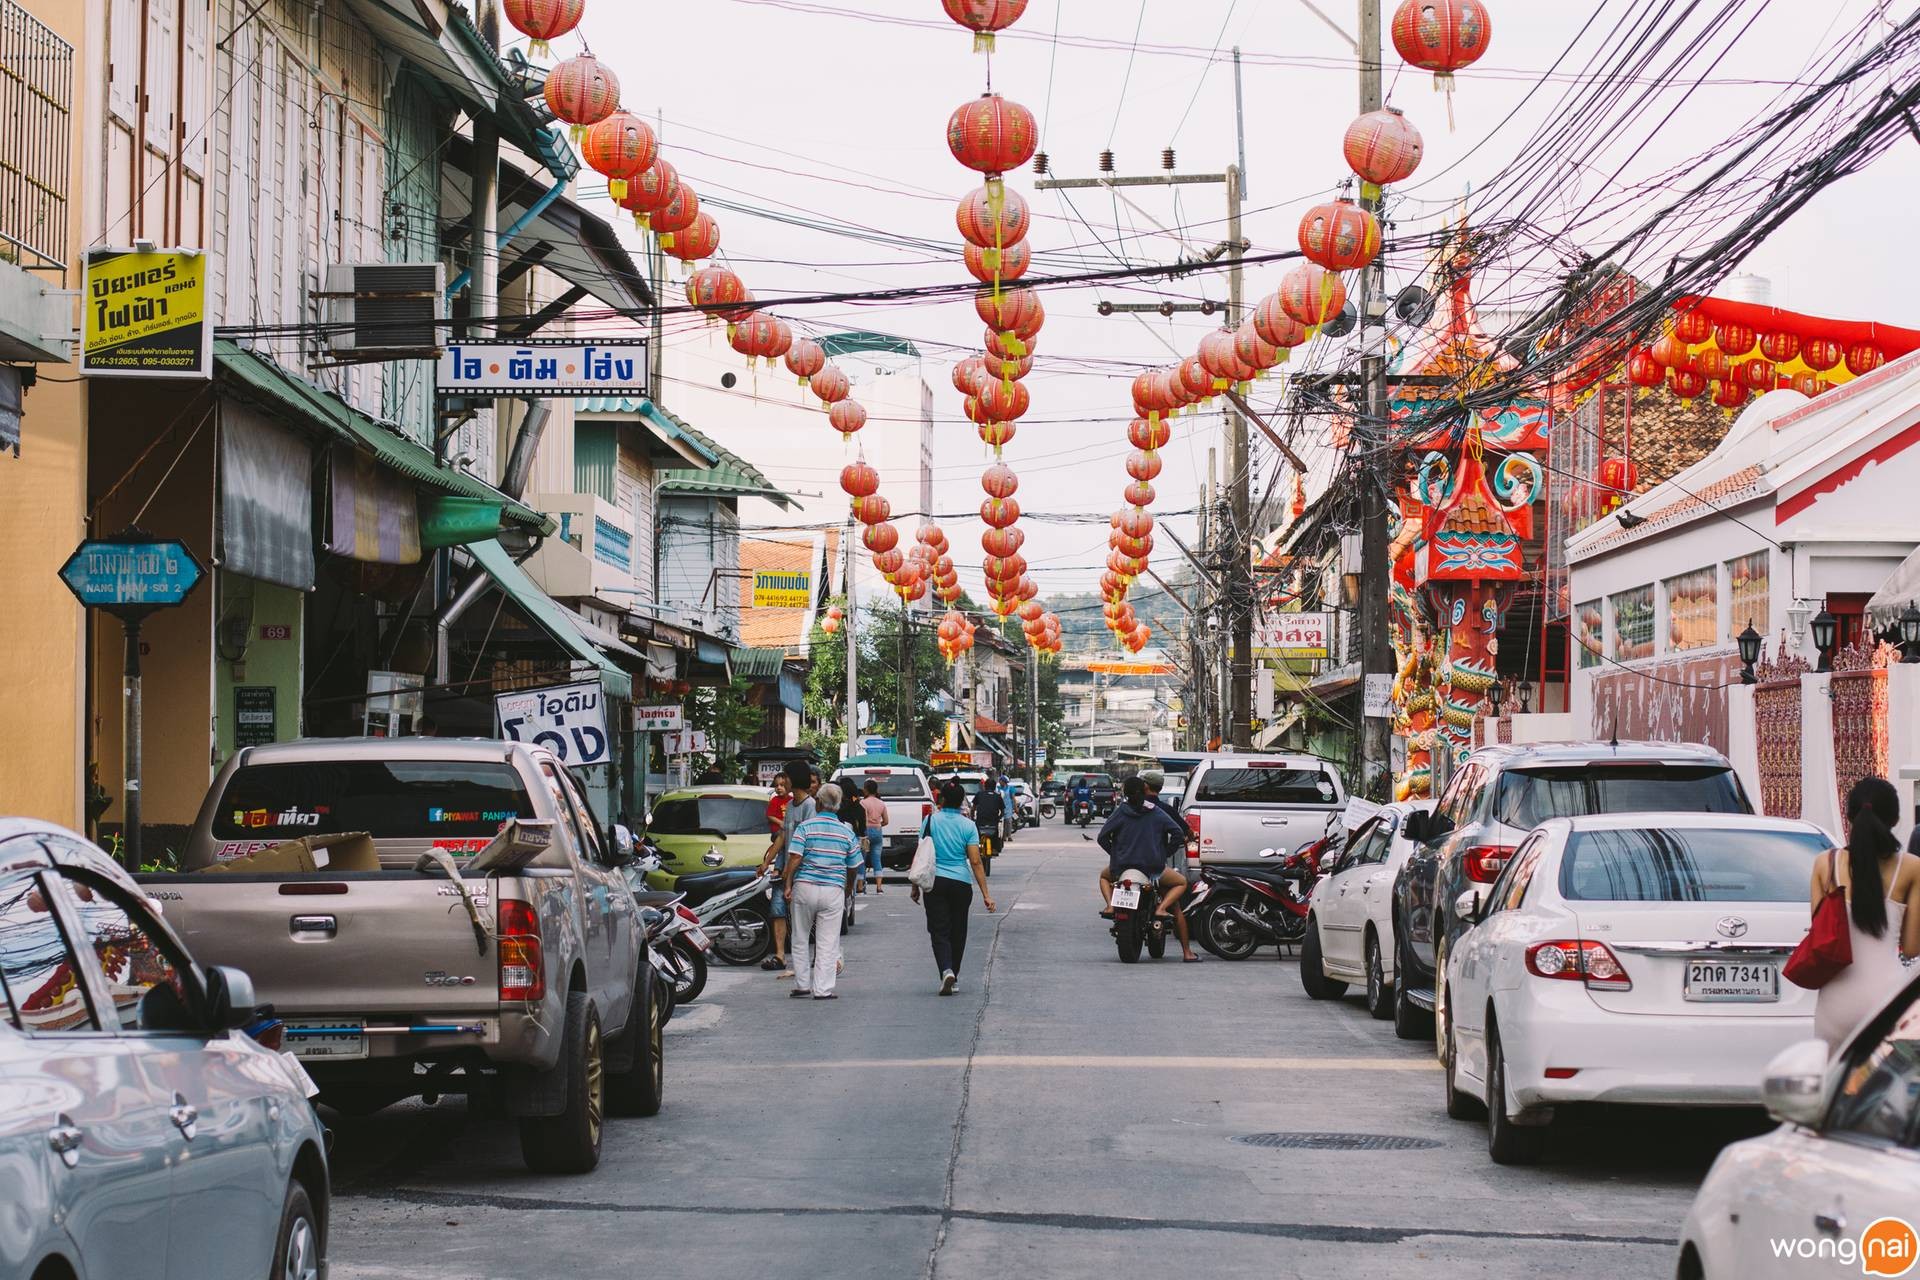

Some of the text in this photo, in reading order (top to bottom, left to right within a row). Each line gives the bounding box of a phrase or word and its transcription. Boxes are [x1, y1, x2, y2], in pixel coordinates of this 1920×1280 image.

[95, 296, 168, 332] ไฟฟ้า
[142, 357, 194, 367] 095-0303271
[448, 347, 633, 381] ไอ ติม โอ่ง
[86, 583, 182, 593] NANG NGAM SOI 2
[267, 627, 286, 639] 69
[537, 690, 598, 717] ไอติม
[443, 811, 480, 822] PIYAWAT
[1692, 965, 1769, 983] 2กด 7341
